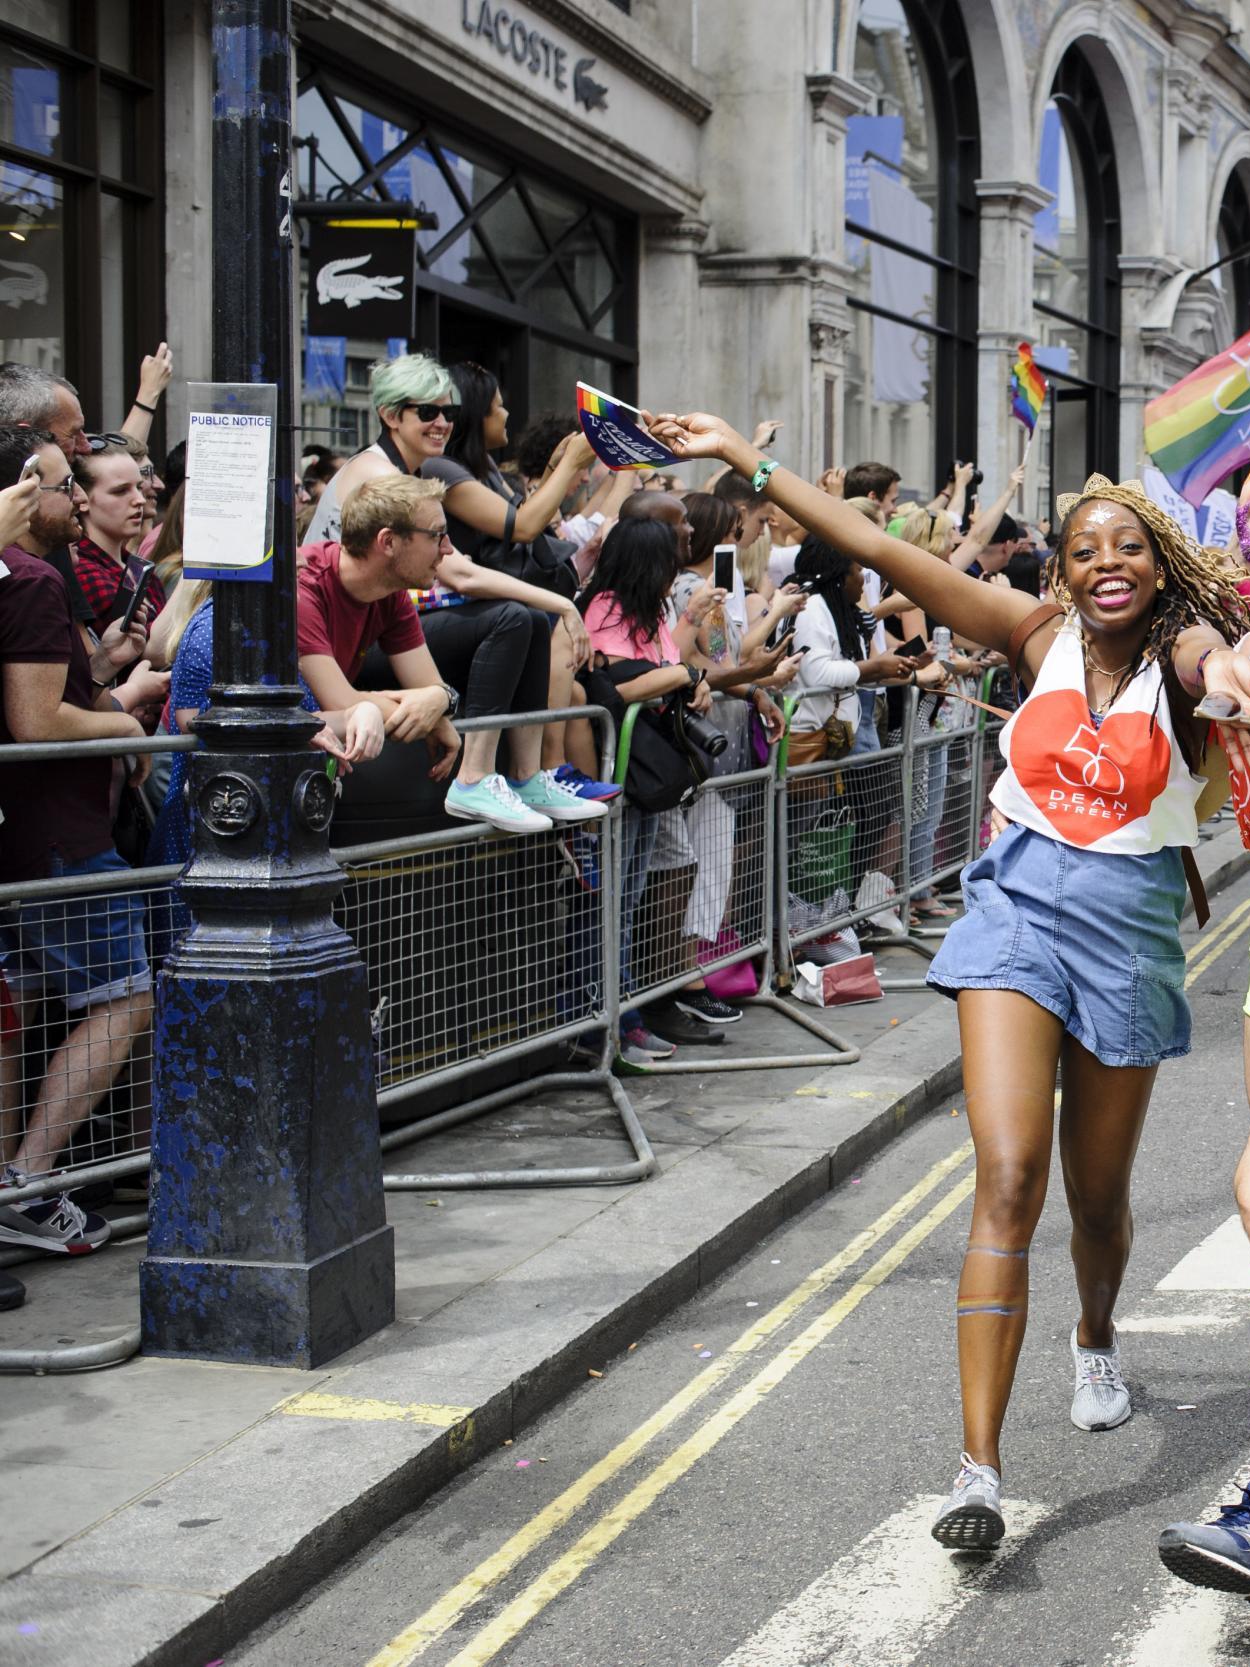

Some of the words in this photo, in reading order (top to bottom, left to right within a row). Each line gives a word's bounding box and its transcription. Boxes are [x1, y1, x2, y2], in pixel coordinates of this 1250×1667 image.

[463, 0, 568, 91] LACOSTE
[191, 415, 229, 427] PUBLIC
[232, 416, 272, 428] NOTICE
[1055, 723, 1124, 796] 56
[1047, 801, 1126, 821] STREET
[1050, 789, 1128, 811] DEAN
